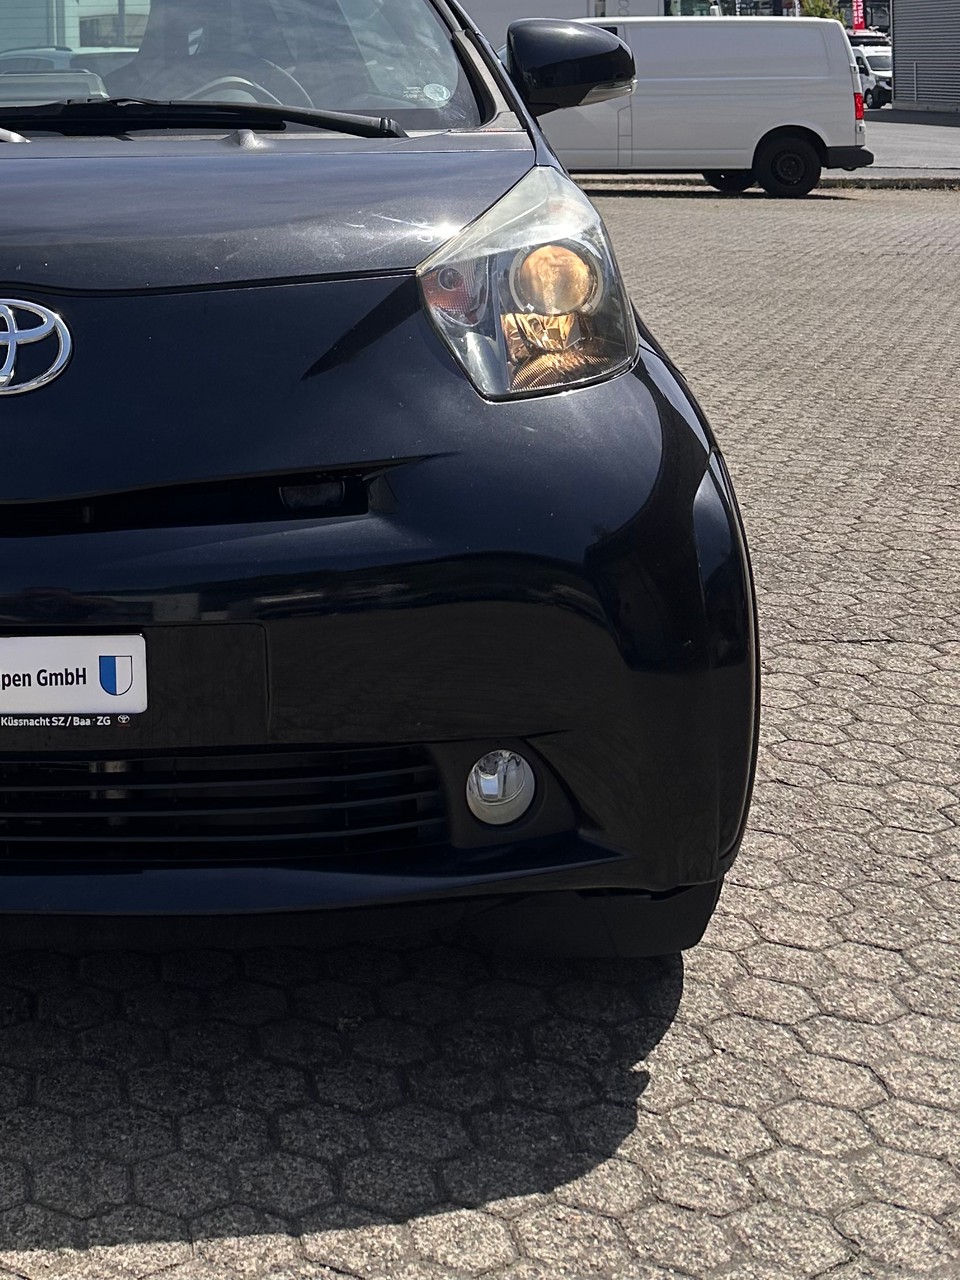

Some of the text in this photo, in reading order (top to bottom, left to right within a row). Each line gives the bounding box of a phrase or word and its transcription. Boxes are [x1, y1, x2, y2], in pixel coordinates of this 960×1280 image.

[36, 667, 87, 687] GmbH
[0, 716, 50, 727] Küssnacht
[51, 716, 65, 726] SZ
[66, 716, 72, 727] /
[96, 716, 111, 726] ZG
